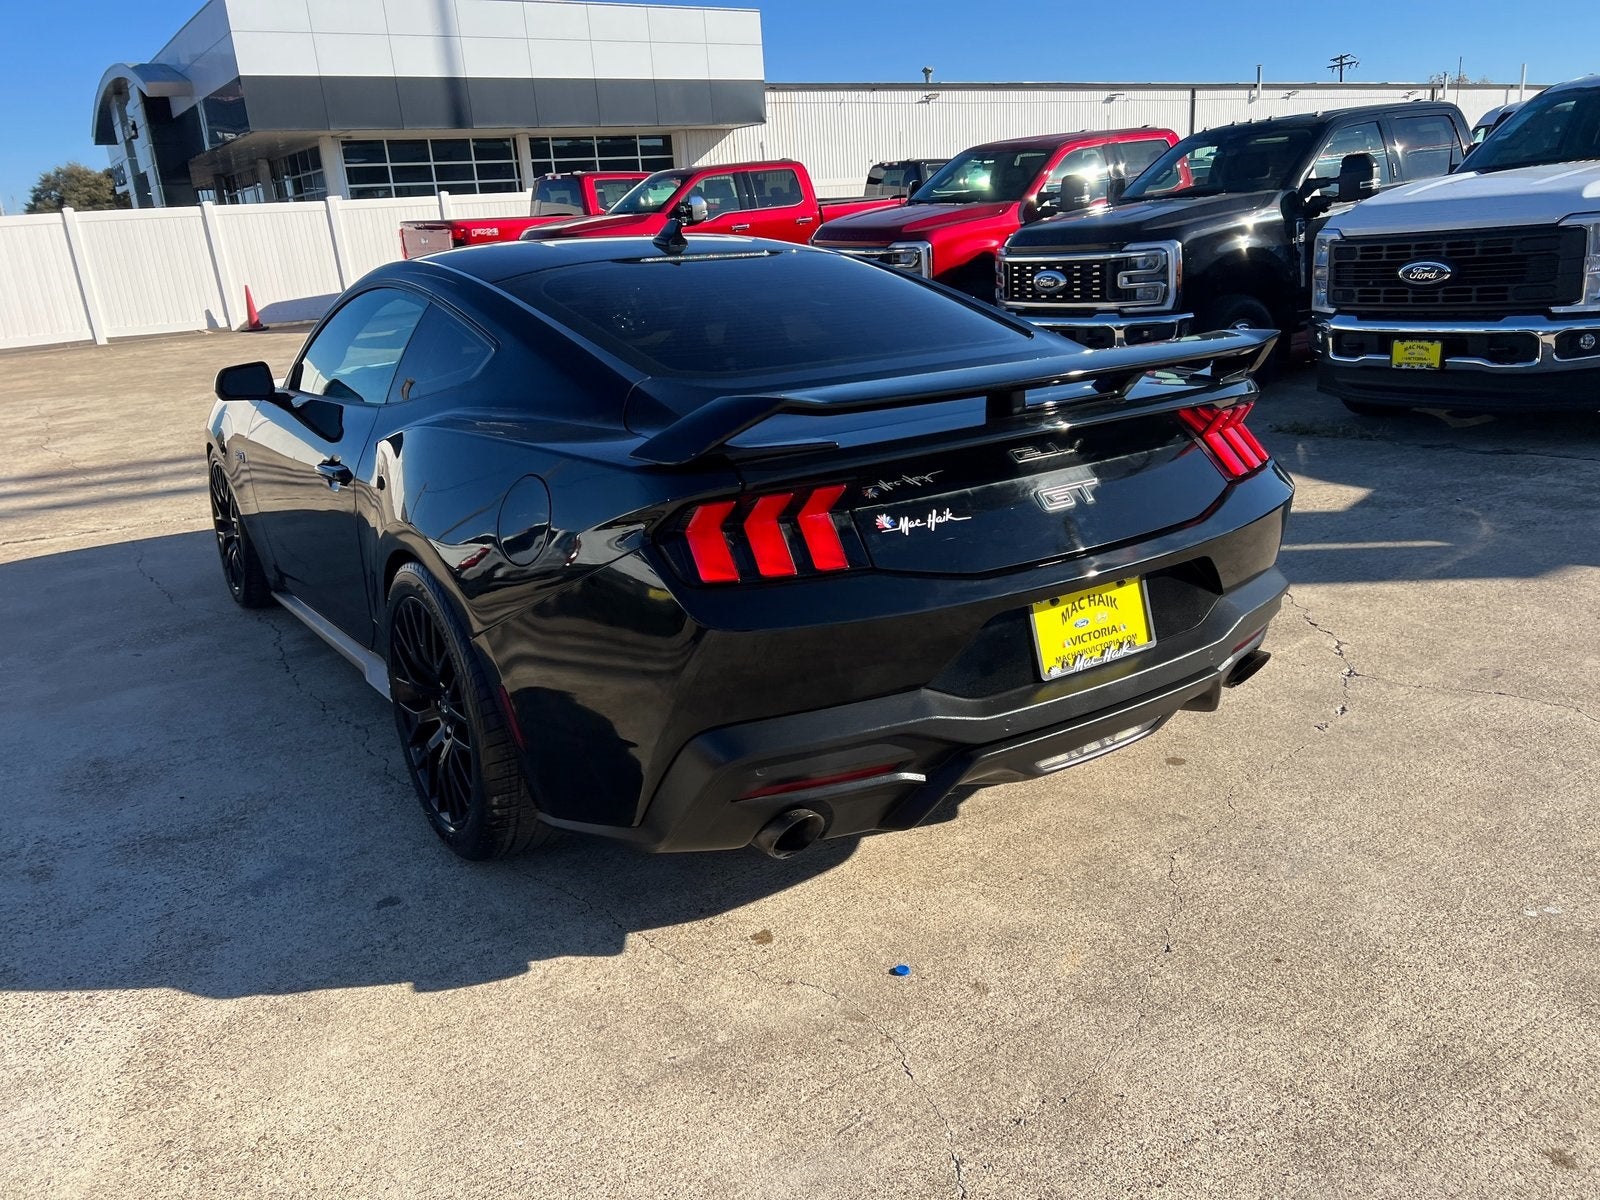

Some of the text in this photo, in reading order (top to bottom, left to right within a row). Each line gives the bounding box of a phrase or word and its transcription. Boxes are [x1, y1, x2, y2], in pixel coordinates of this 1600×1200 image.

[1409, 266, 1438, 280] Ford
[1033, 477, 1099, 513] GT
[882, 508, 972, 536] Mac Haik
[1061, 597, 1086, 626] MAC
[1087, 594, 1119, 610] HAIK
[1070, 624, 1118, 646] VICTORIA
[1064, 638, 1140, 673] Mac Haik
